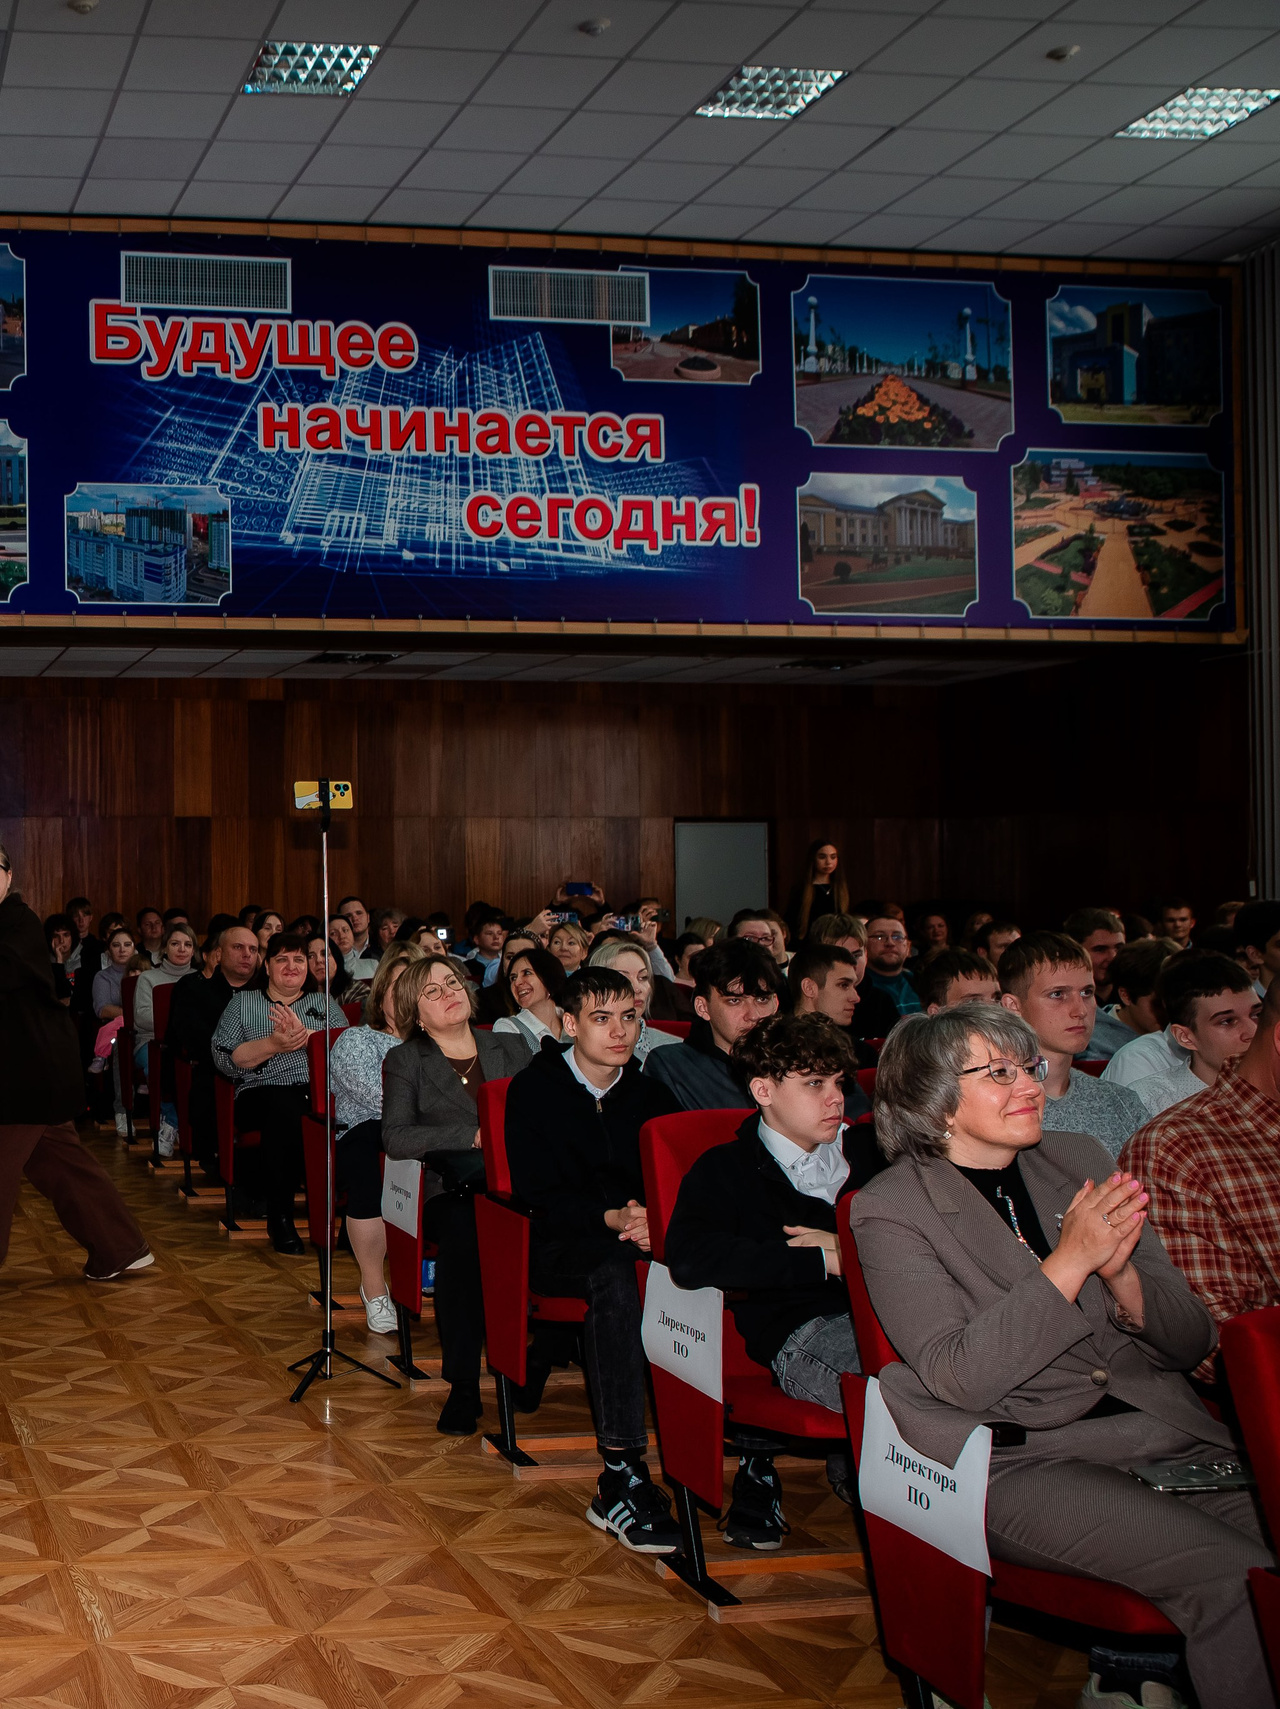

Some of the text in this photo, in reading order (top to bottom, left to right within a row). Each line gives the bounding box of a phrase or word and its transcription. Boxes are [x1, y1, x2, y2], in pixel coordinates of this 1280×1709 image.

[90, 300, 418, 382] Будущее
[257, 402, 665, 461] начинается
[463, 484, 760, 554] сегодня!
[658, 1310, 706, 1343] Директора
[673, 1340, 689, 1358] ПО
[884, 1443, 957, 1493] Директора
[907, 1484, 930, 1510] ПО
